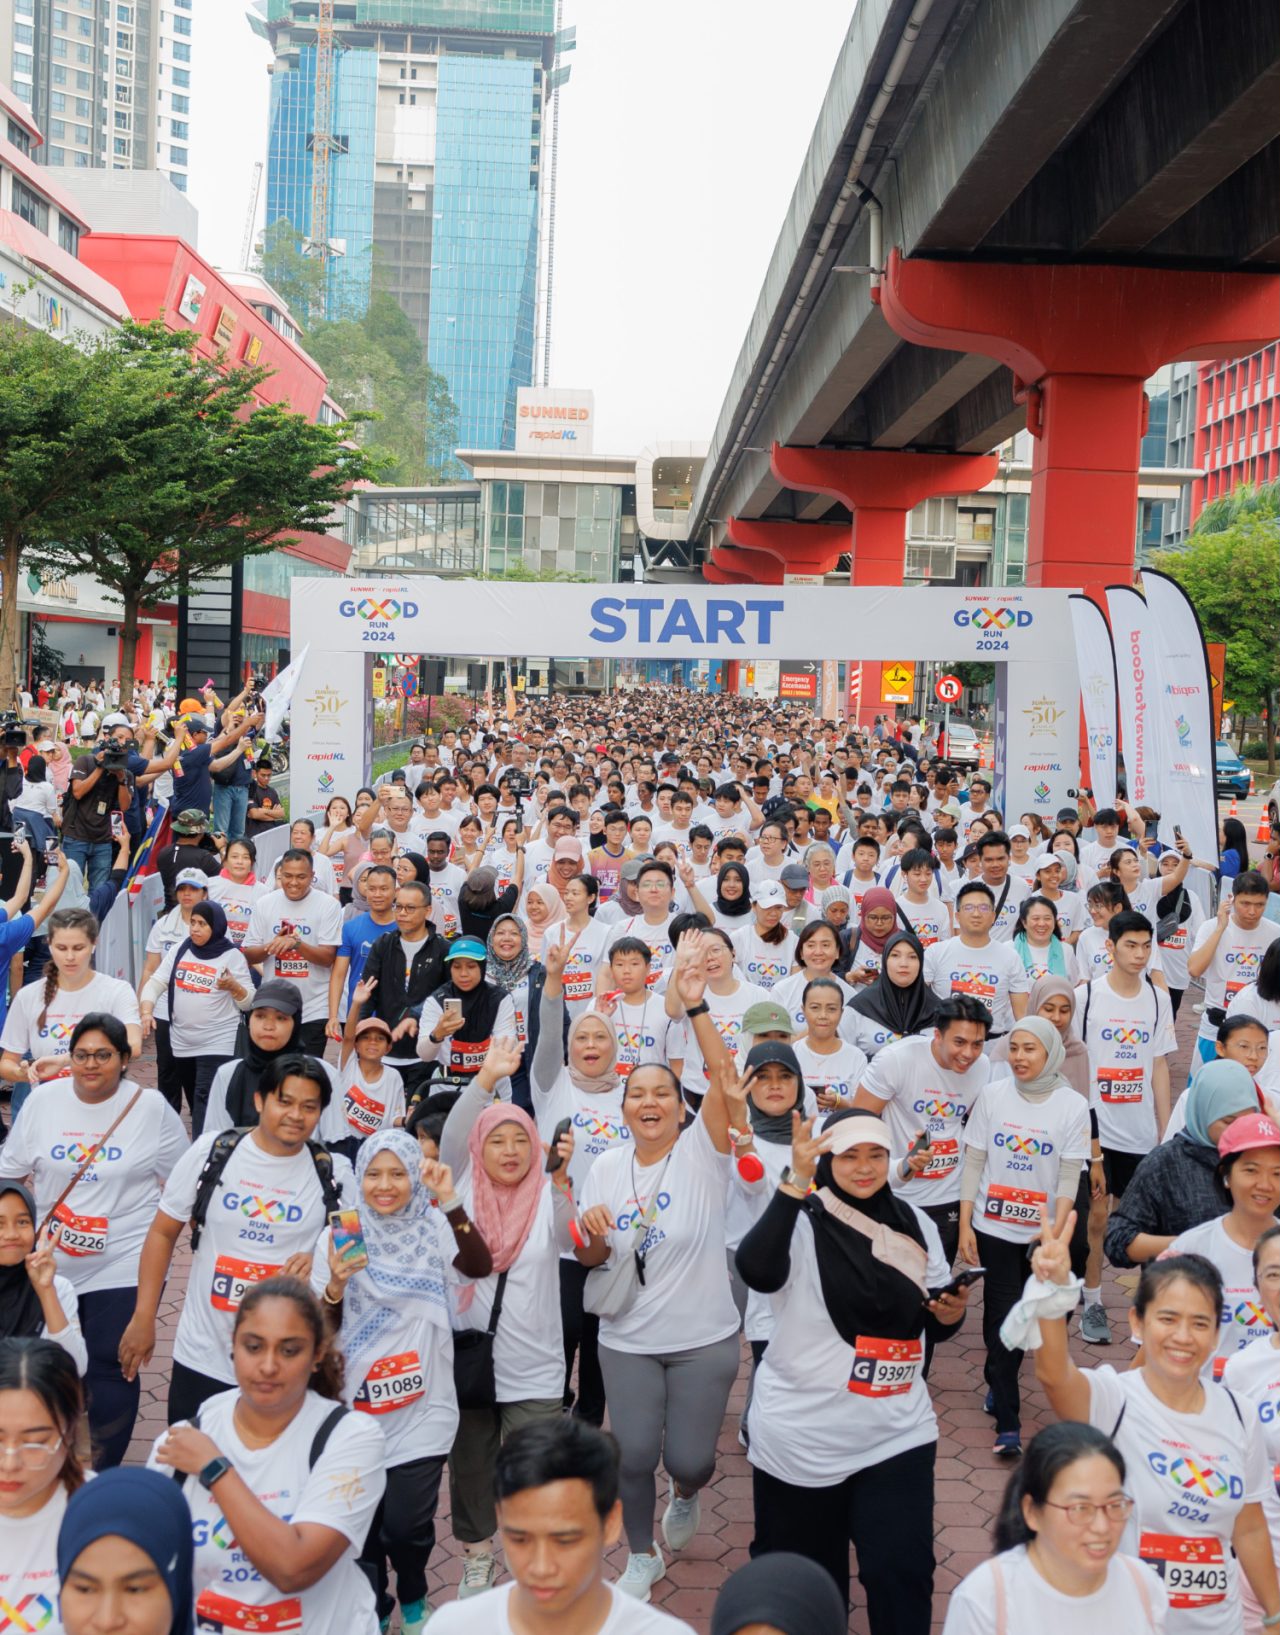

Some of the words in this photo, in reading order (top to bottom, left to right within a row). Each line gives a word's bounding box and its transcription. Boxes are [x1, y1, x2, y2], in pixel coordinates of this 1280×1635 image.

[519, 406, 589, 421] SUNMED
[529, 429, 578, 441] rapidKL
[369, 621, 389, 629] RUN
[588, 597, 784, 644] START
[361, 631, 396, 642] 2024
[983, 630, 1003, 638] RUN
[976, 640, 1010, 651] 2024
[782, 675, 810, 684] Emergency
[307, 752, 346, 761] rapidKL
[1023, 763, 1063, 772] rapidKL
[282, 961, 309, 971] 93834
[176, 968, 185, 980] G
[186, 972, 213, 987] 92689
[566, 982, 592, 995] 93227
[451, 1053, 461, 1065] G
[1114, 1051, 1137, 1060] 2024
[1099, 1081, 1108, 1094] G
[1113, 1082, 1143, 1094] 93275
[351, 1108, 380, 1128] 93887
[591, 1137, 609, 1146] RUN
[926, 1155, 959, 1171] 92128
[1013, 1153, 1029, 1162] RUN
[1006, 1160, 1033, 1173] 2024
[986, 1199, 999, 1214] G
[1005, 1203, 1041, 1222] 93873
[249, 1219, 270, 1231] RUN
[63, 1229, 105, 1251] 92226
[238, 1228, 275, 1245] 2024
[213, 1276, 226, 1295] G
[1247, 1328, 1270, 1337] RUN
[854, 1361, 871, 1380] G
[877, 1362, 916, 1382] 93971
[371, 1374, 424, 1399] 91089
[1181, 1491, 1209, 1507] RUN
[1167, 1501, 1210, 1524] 2024
[222, 1568, 262, 1583] 202
[1168, 1565, 1228, 1590] 93403
